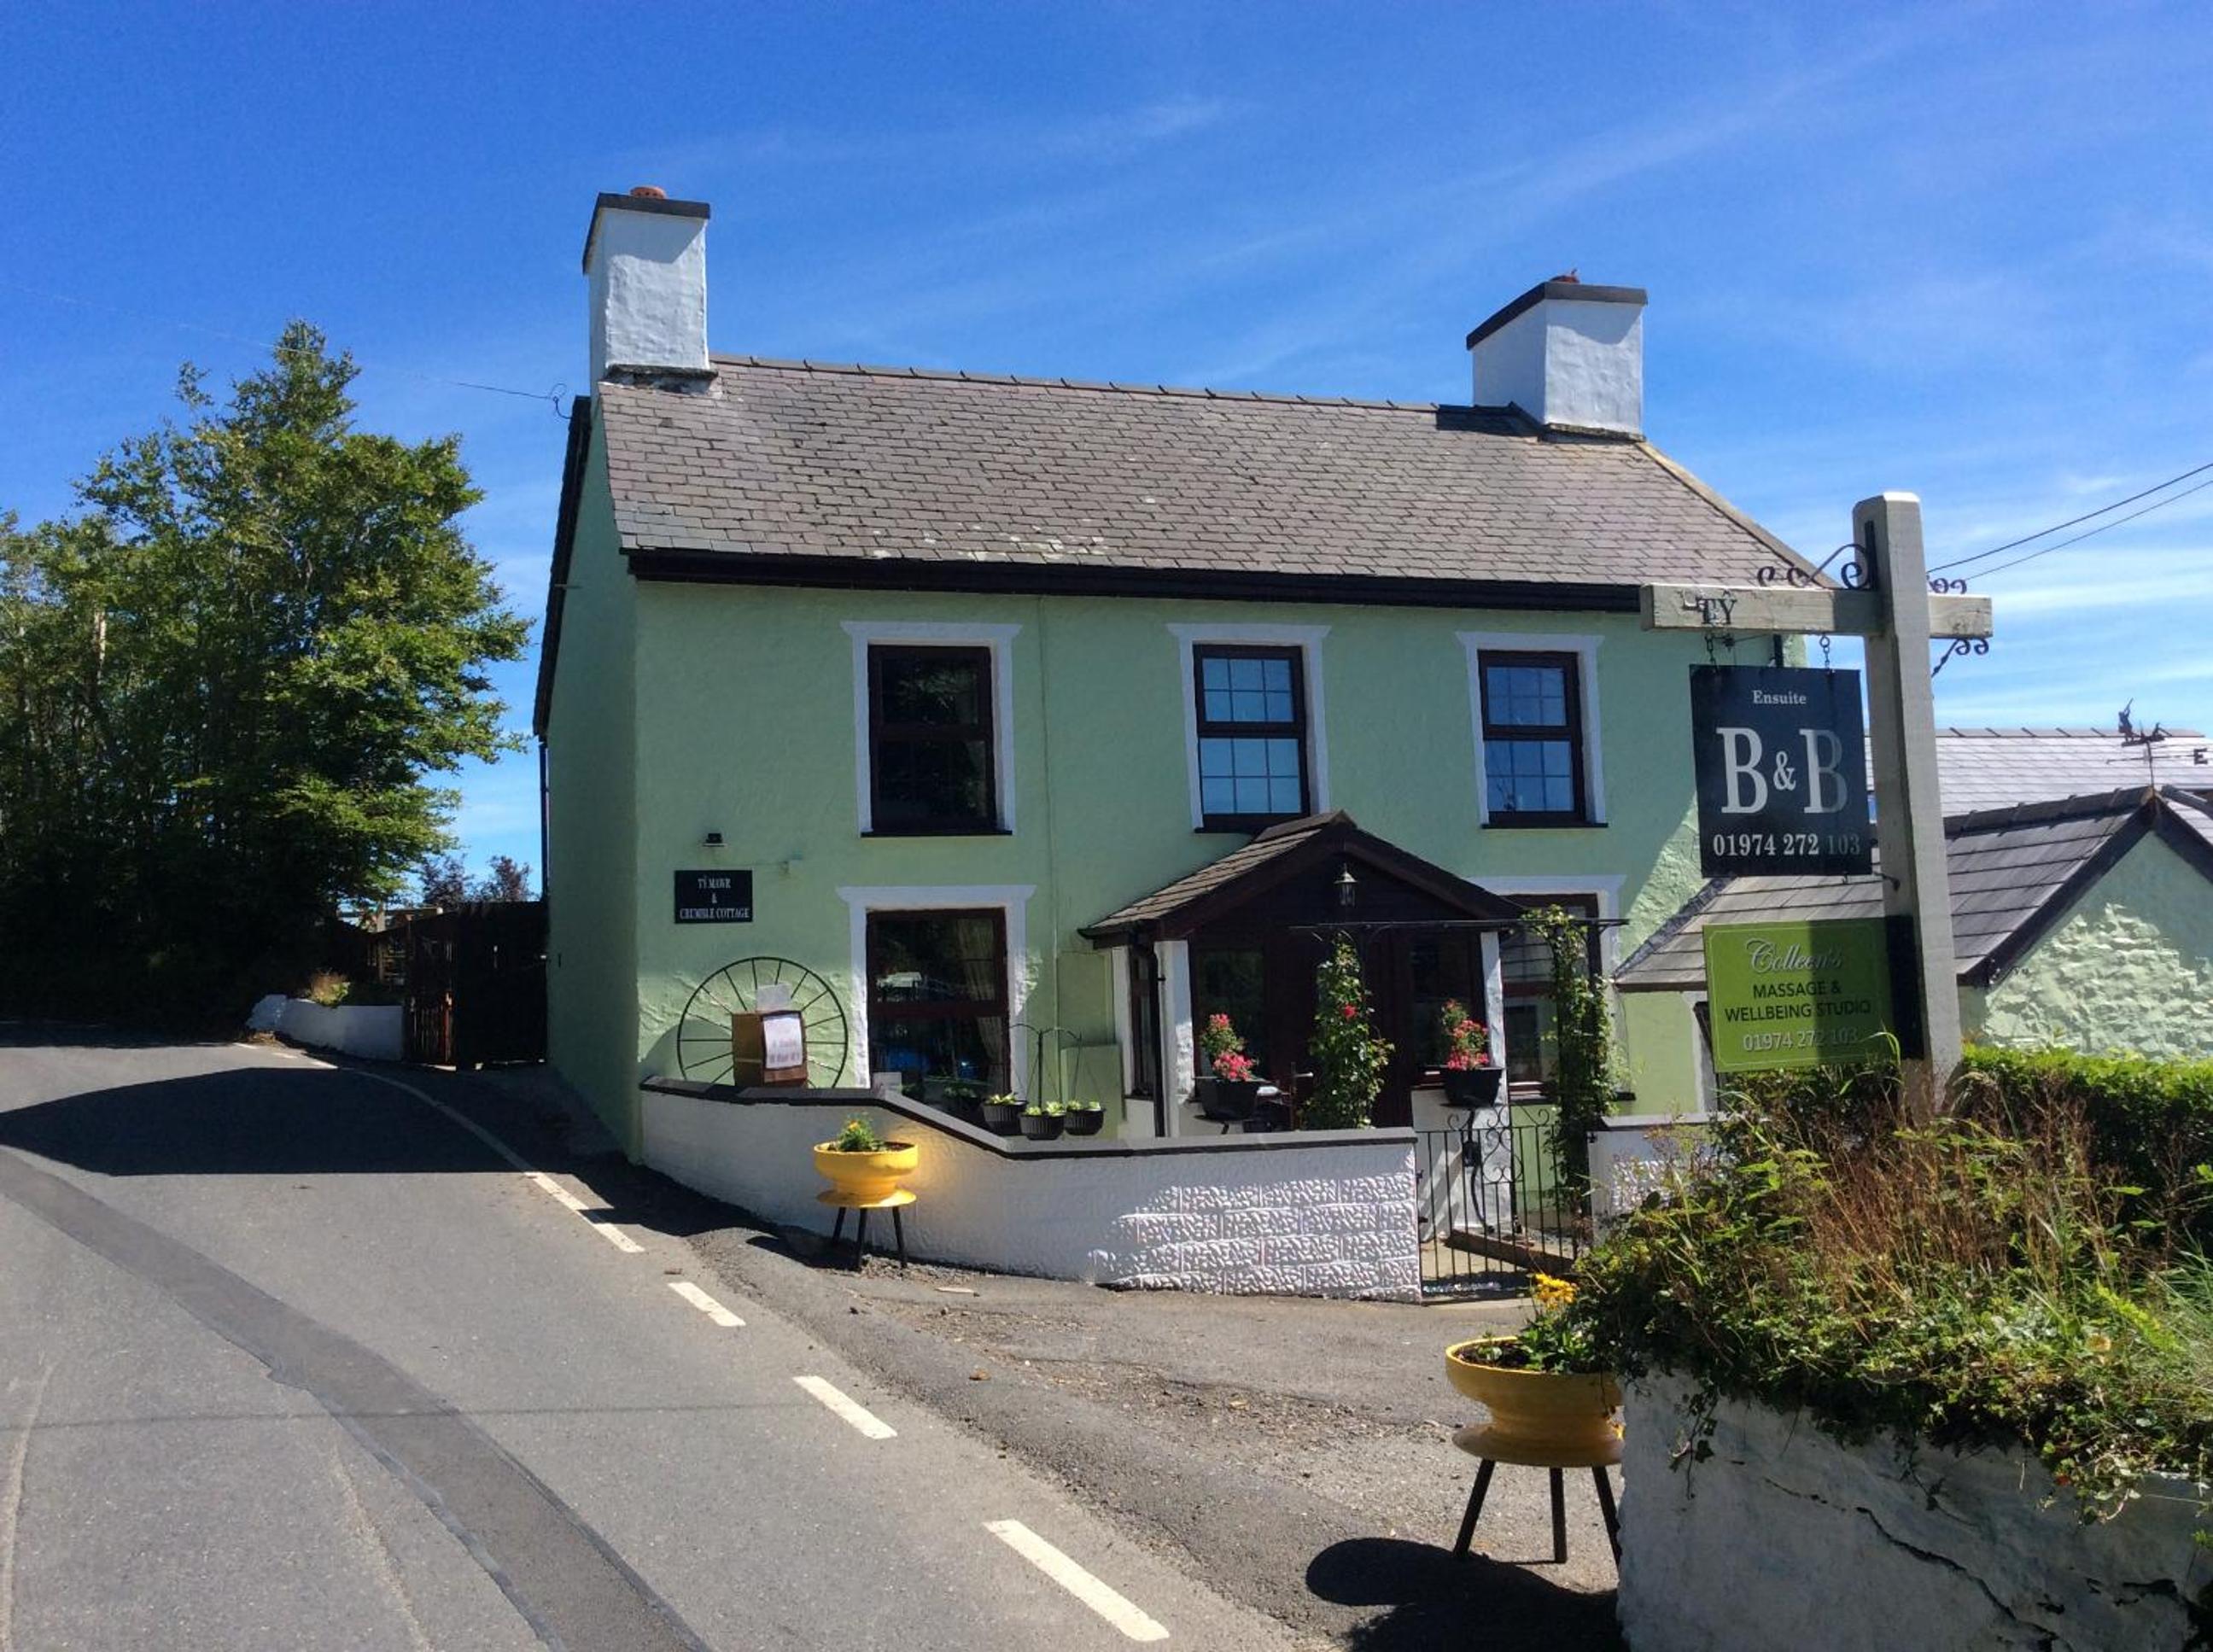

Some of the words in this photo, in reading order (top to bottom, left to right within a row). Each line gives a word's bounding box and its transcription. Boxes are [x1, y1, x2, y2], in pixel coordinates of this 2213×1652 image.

[1752, 689, 1807, 705] Ensuite
[1715, 727, 1848, 814] B&B
[1713, 833, 1776, 856] 01974
[1783, 833, 1819, 855] 272
[1828, 833, 1860, 855] 103
[1744, 937, 1842, 974] Colleen's
[1751, 981, 1825, 1000] MASSAGE
[1830, 979, 1842, 995] &
[1725, 1004, 1811, 1024] WELLBEING
[1816, 999, 1872, 1018] STUDIO
[1743, 1030, 1793, 1051] 01974
[1795, 1029, 1825, 1048] 272
[1830, 1025, 1860, 1045] 103
